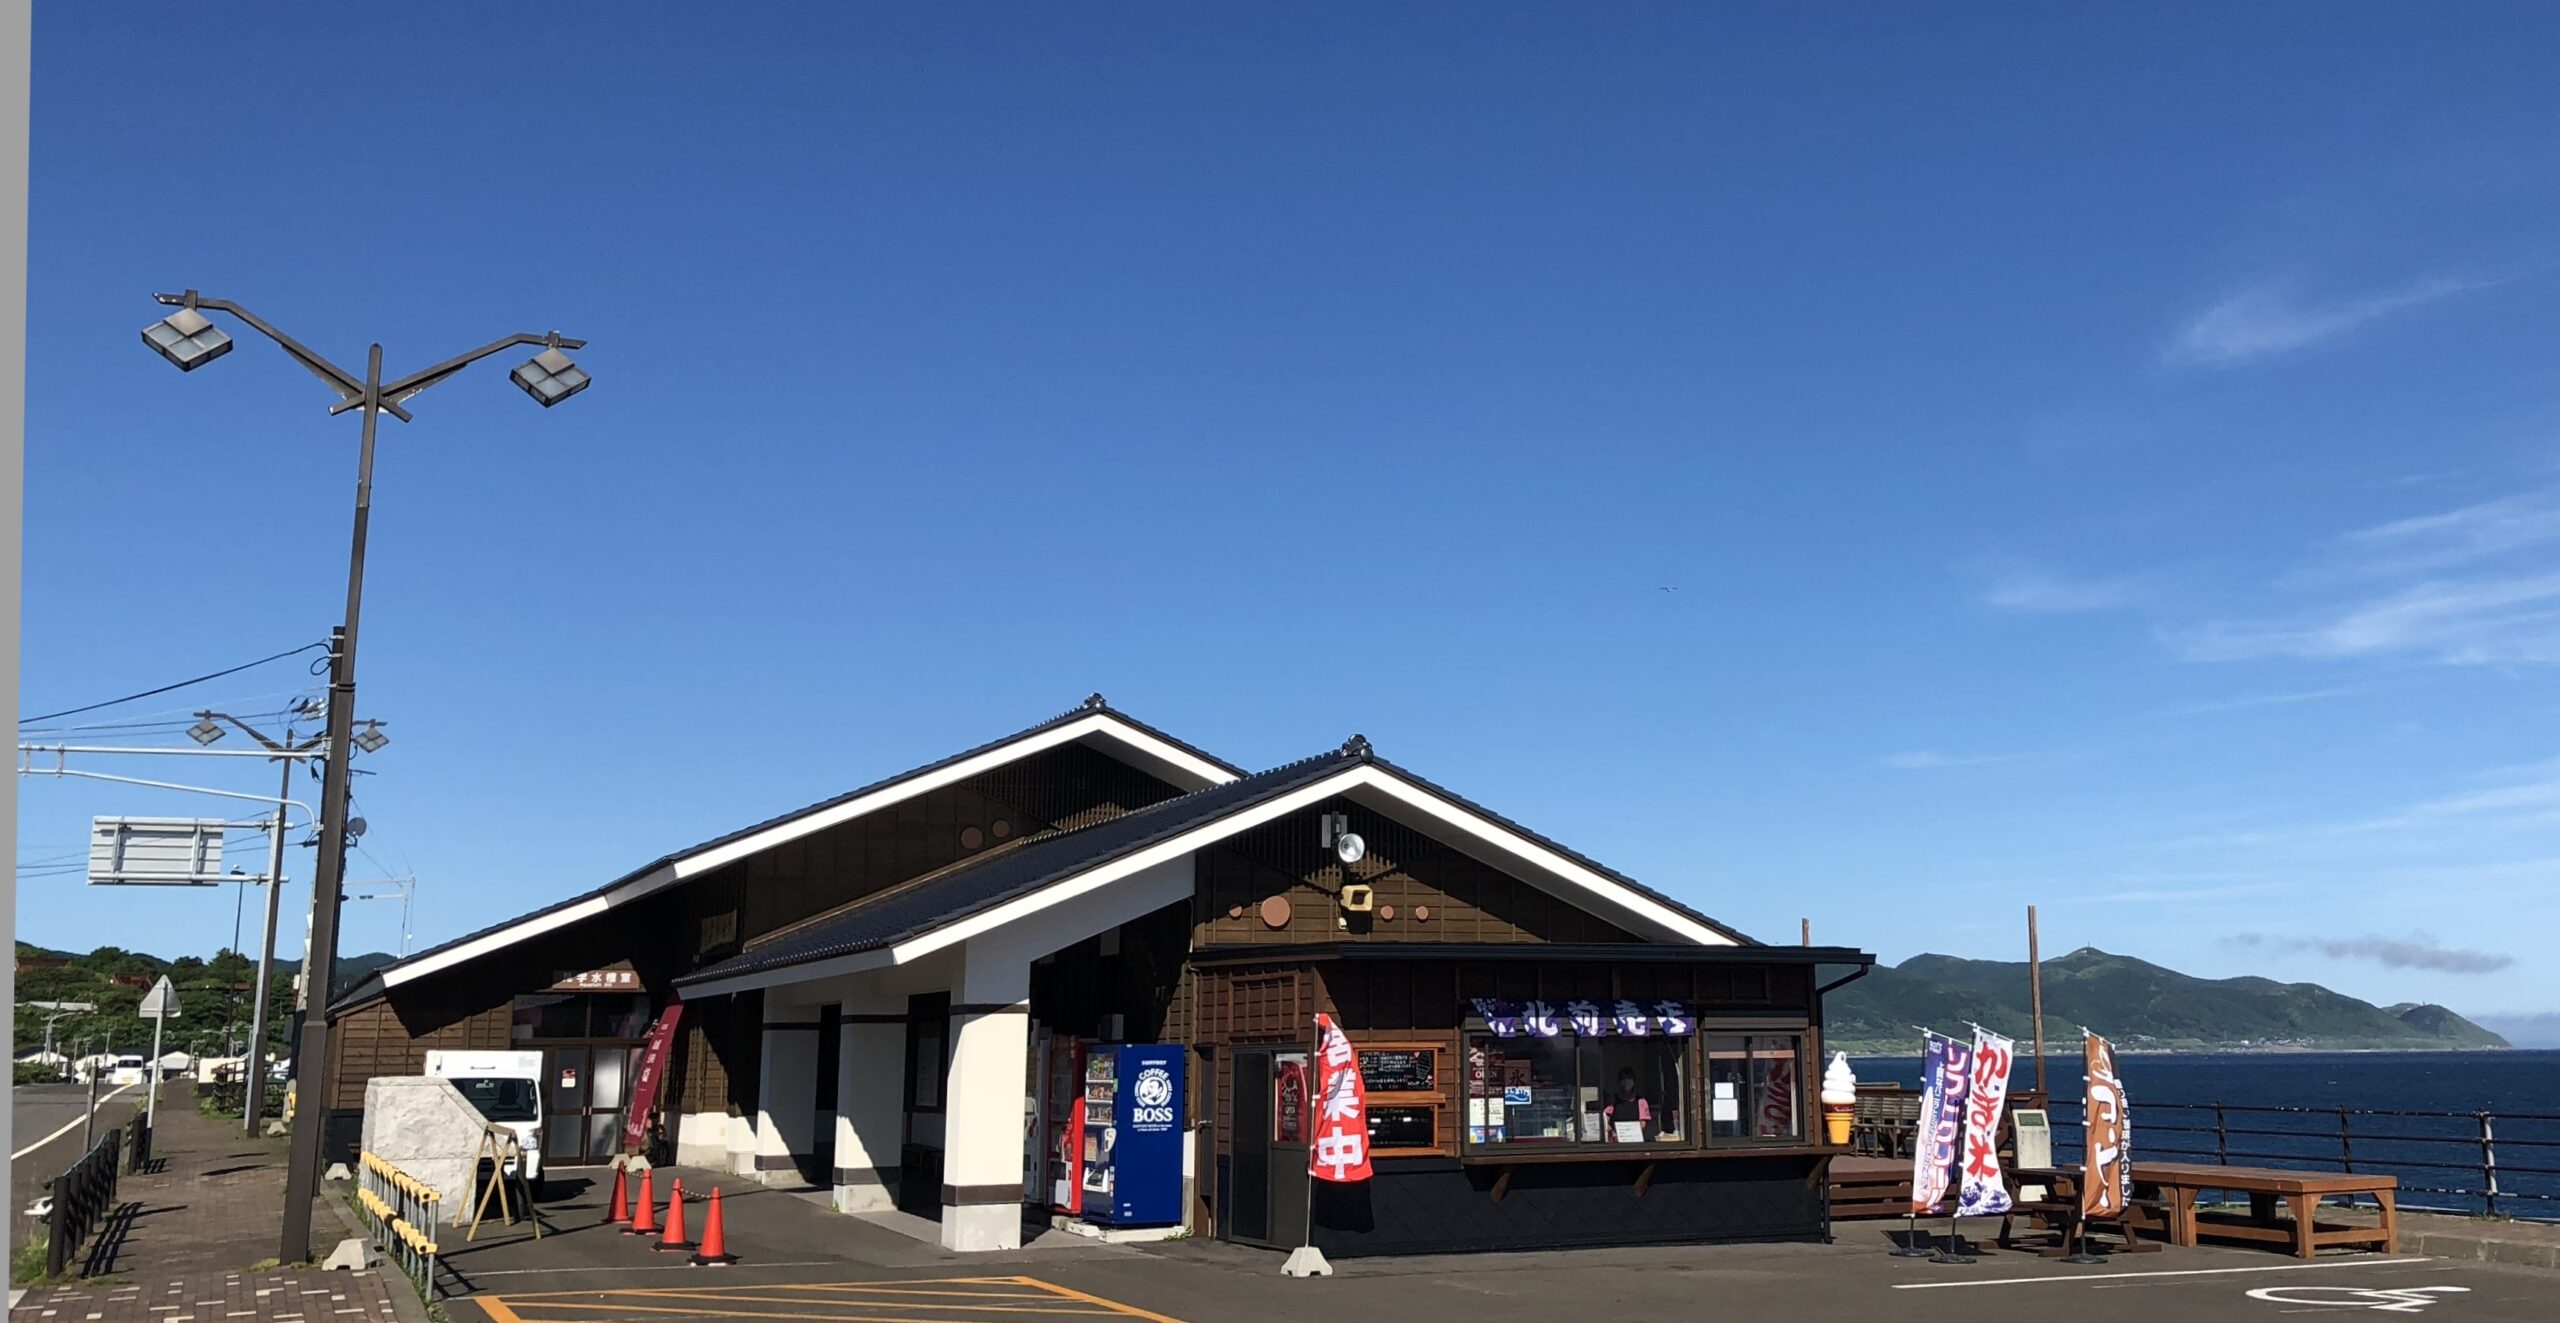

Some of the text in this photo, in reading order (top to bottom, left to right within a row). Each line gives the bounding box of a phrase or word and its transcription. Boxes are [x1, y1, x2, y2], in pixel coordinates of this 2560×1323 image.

[1521, 999, 1688, 1036] 北前売店
[1138, 1068, 1170, 1080] COFFEE
[1132, 1106, 1173, 1123] BOSS
[1316, 1024, 1364, 1180] 営業中
[1966, 1040, 2009, 1182] かき氷
